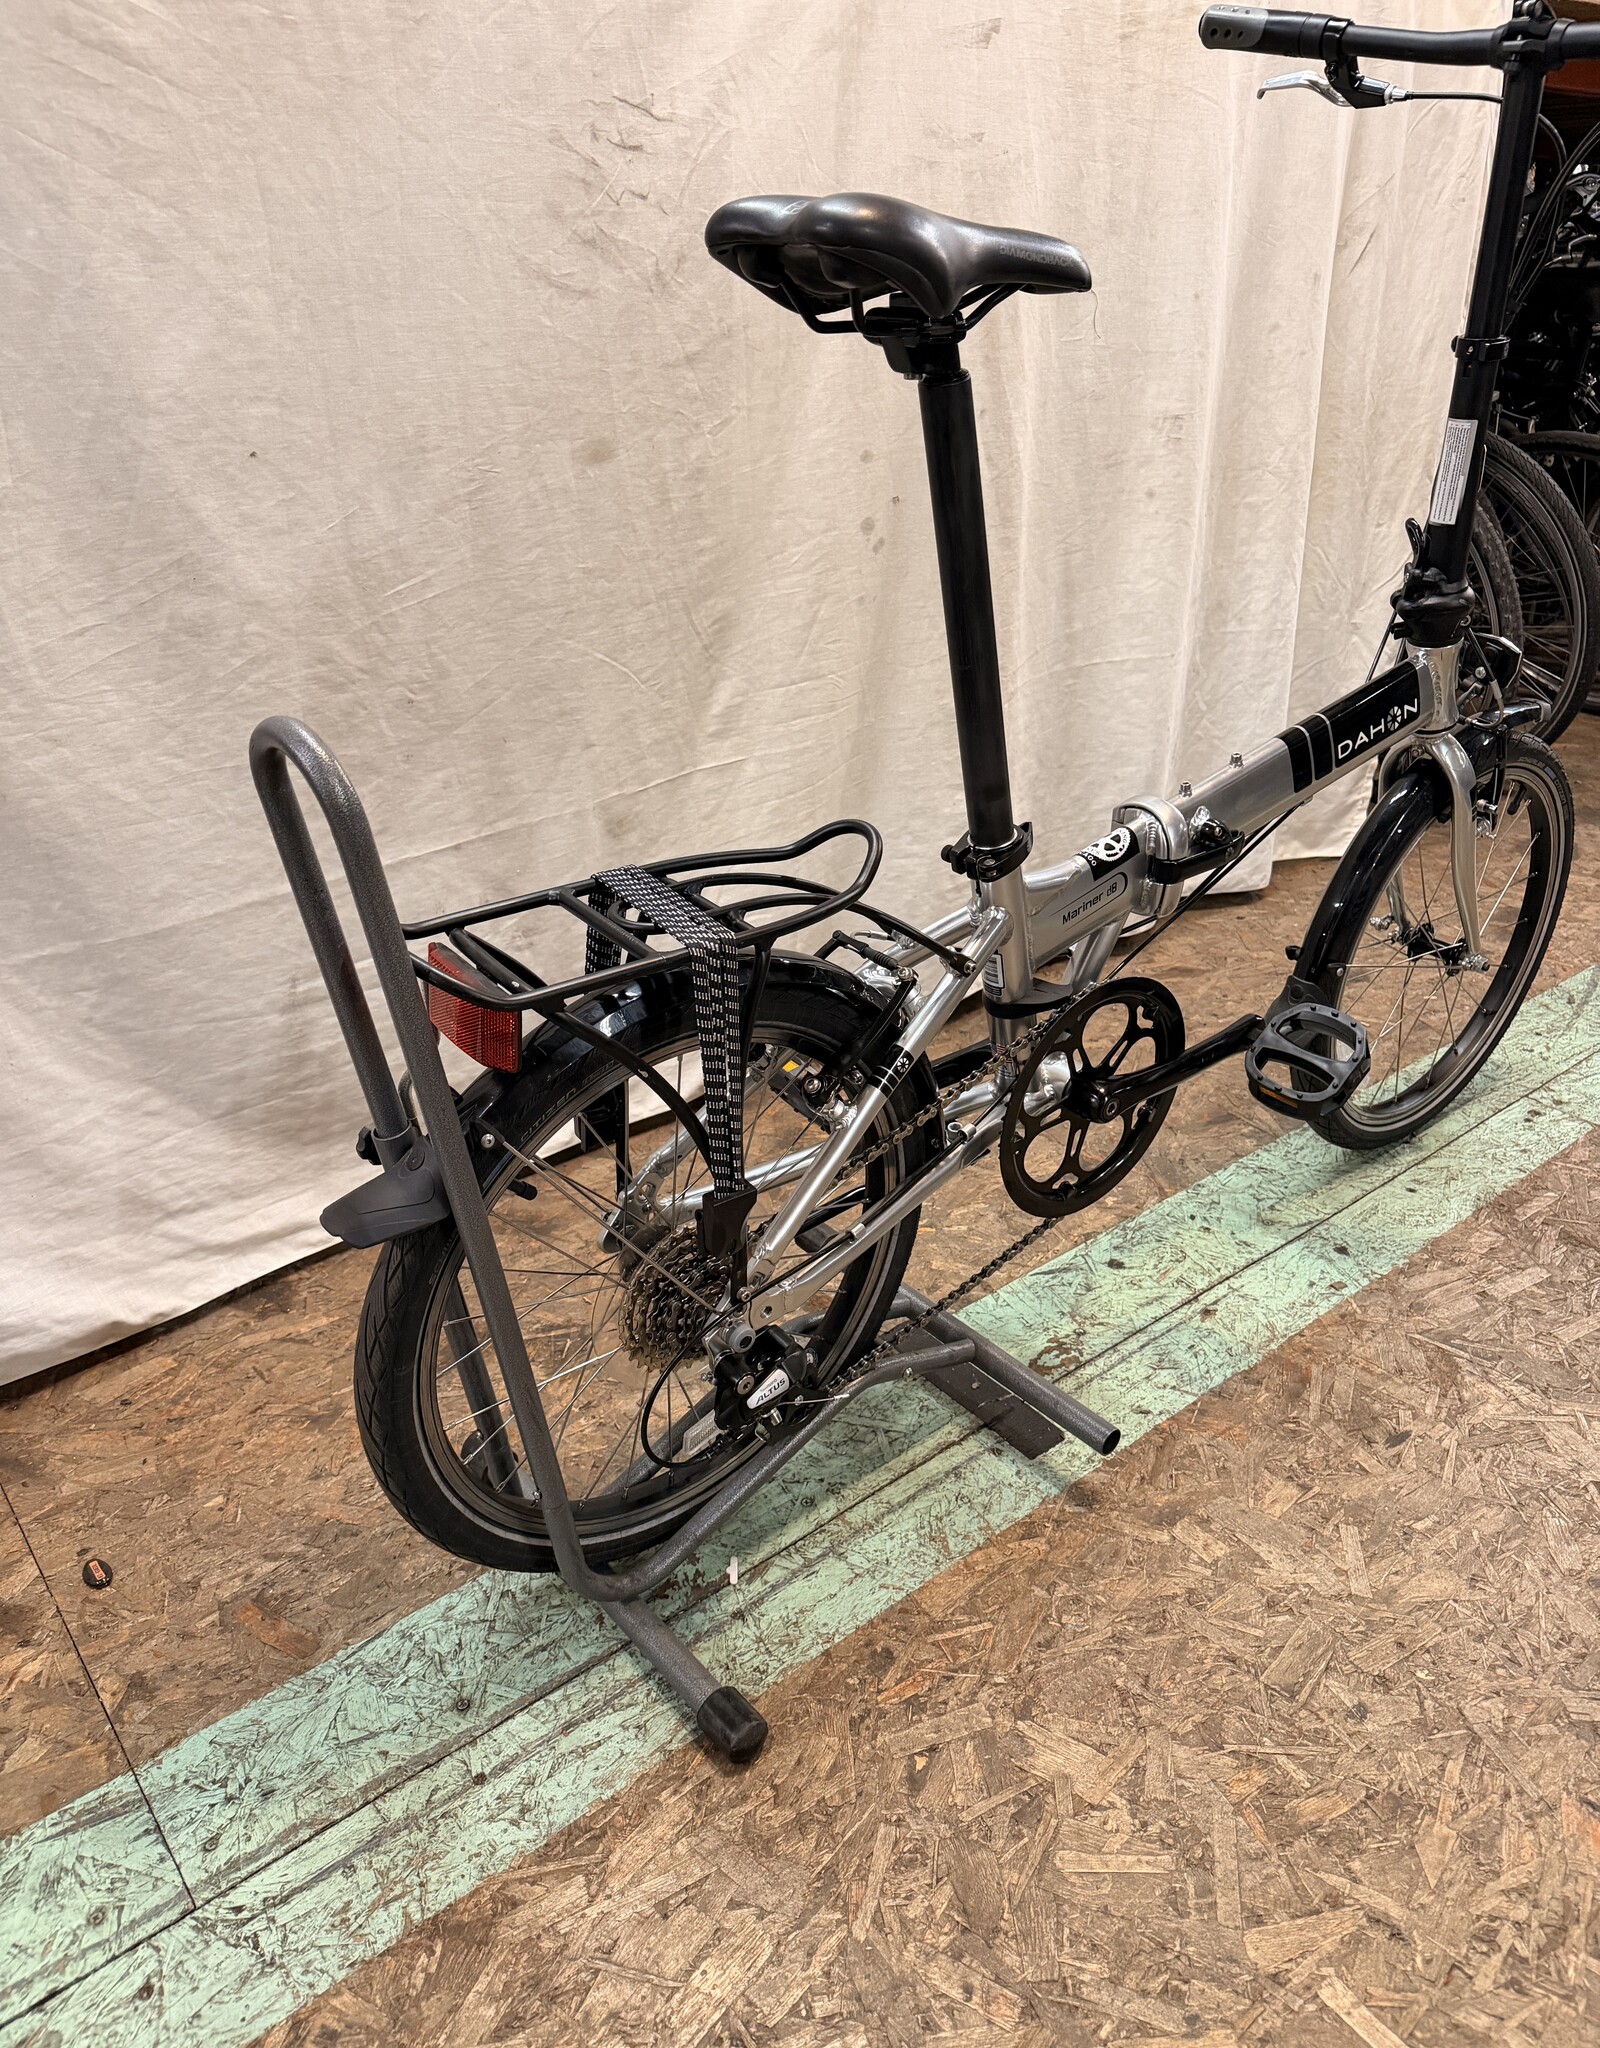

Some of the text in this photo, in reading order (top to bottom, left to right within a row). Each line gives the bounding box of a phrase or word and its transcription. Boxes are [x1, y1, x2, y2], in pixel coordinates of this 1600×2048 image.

[1338, 698, 1418, 759] DAHON
[1062, 892, 1103, 924] Mariner
[756, 1378, 786, 1405] ALTUS
